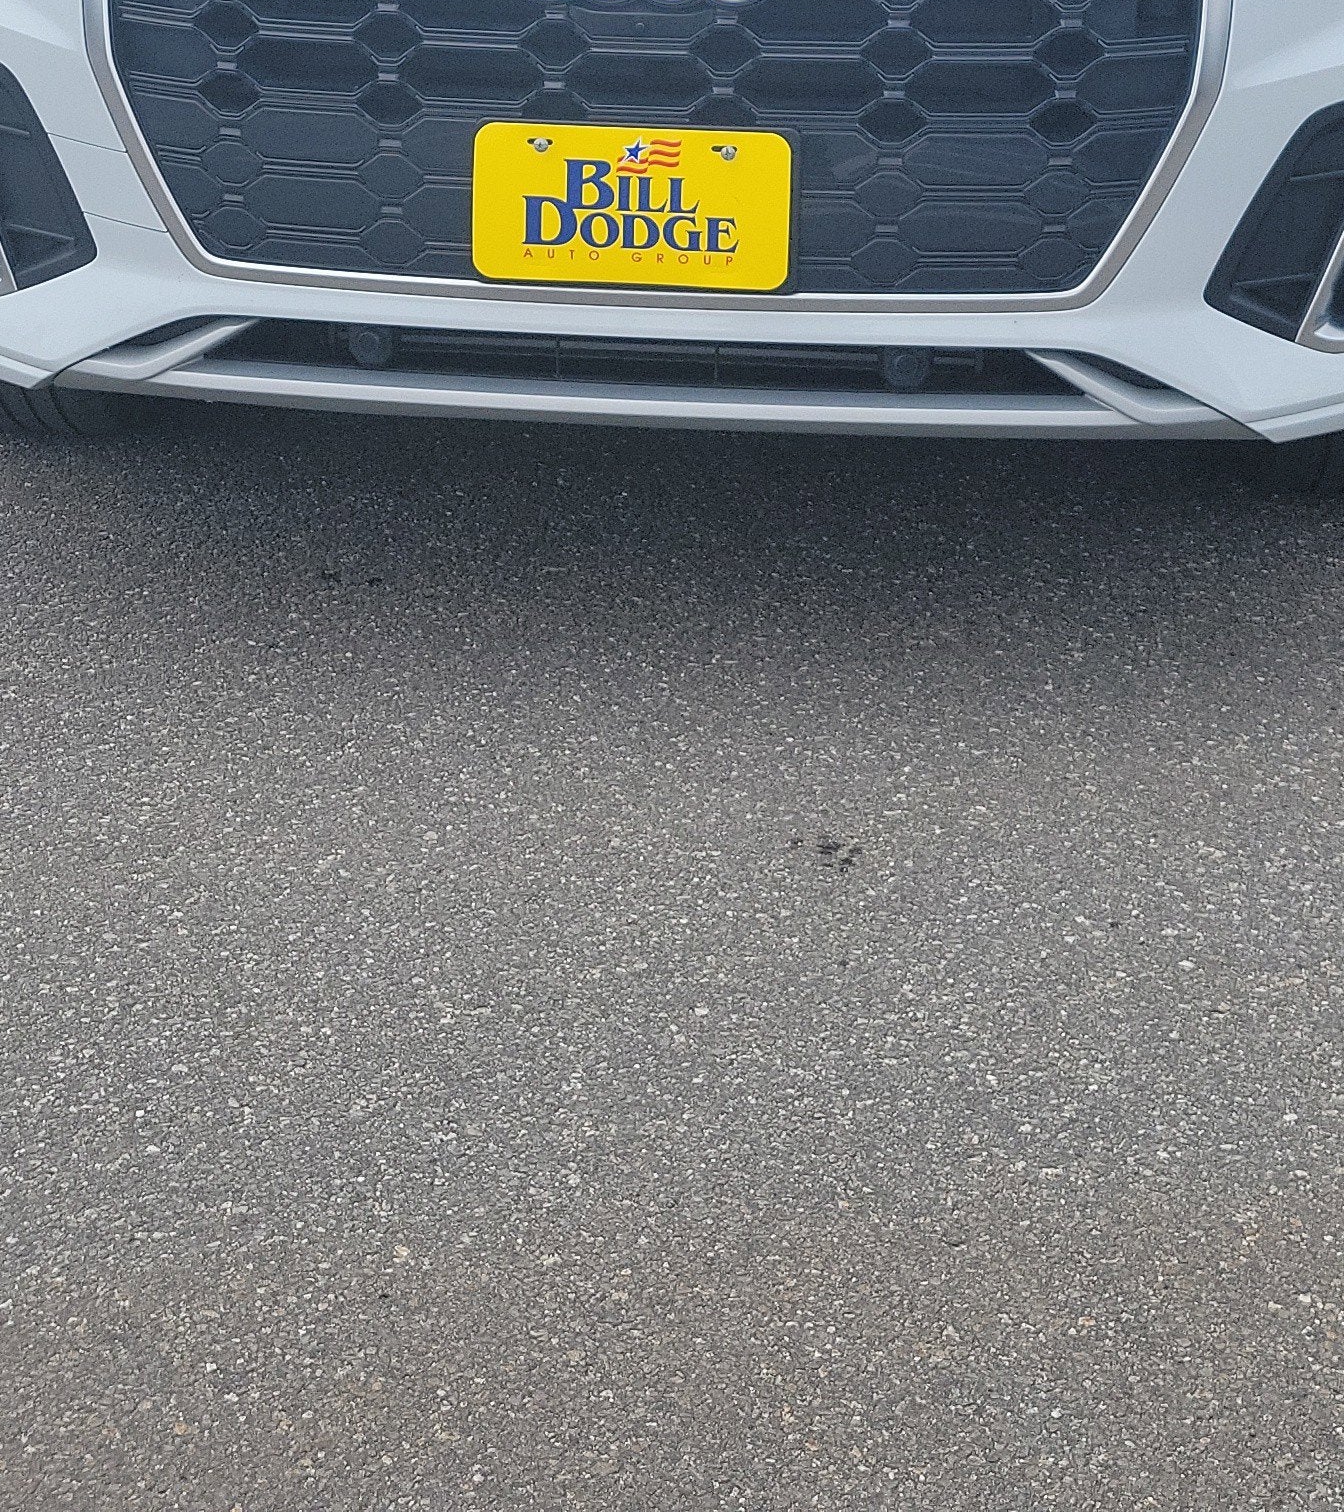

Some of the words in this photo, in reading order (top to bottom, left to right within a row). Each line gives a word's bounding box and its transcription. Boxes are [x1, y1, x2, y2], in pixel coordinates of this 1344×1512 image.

[564, 158, 700, 214] BILL
[522, 195, 739, 253] DODGE
[523, 247, 600, 261] AUTO
[631, 252, 734, 266] GROUP
